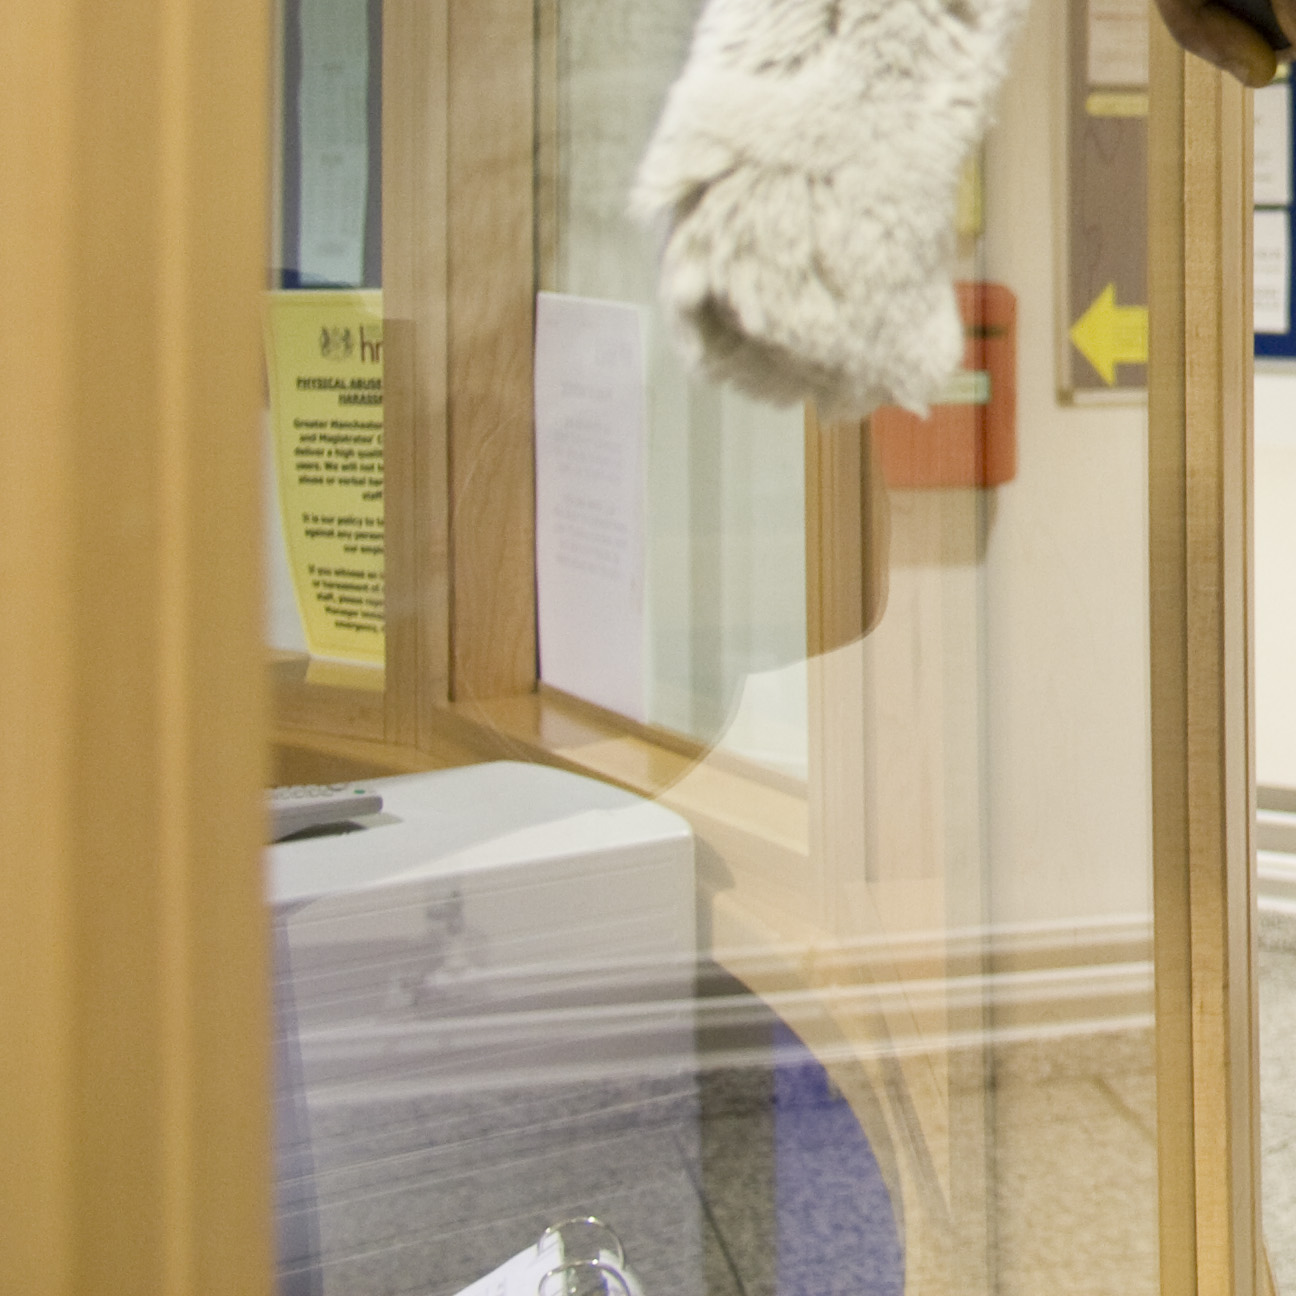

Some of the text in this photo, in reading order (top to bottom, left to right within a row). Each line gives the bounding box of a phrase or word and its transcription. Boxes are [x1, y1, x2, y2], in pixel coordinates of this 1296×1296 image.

[296, 375, 382, 391] PHYSICAL ABUSE
[294, 418, 328, 430] Greater
